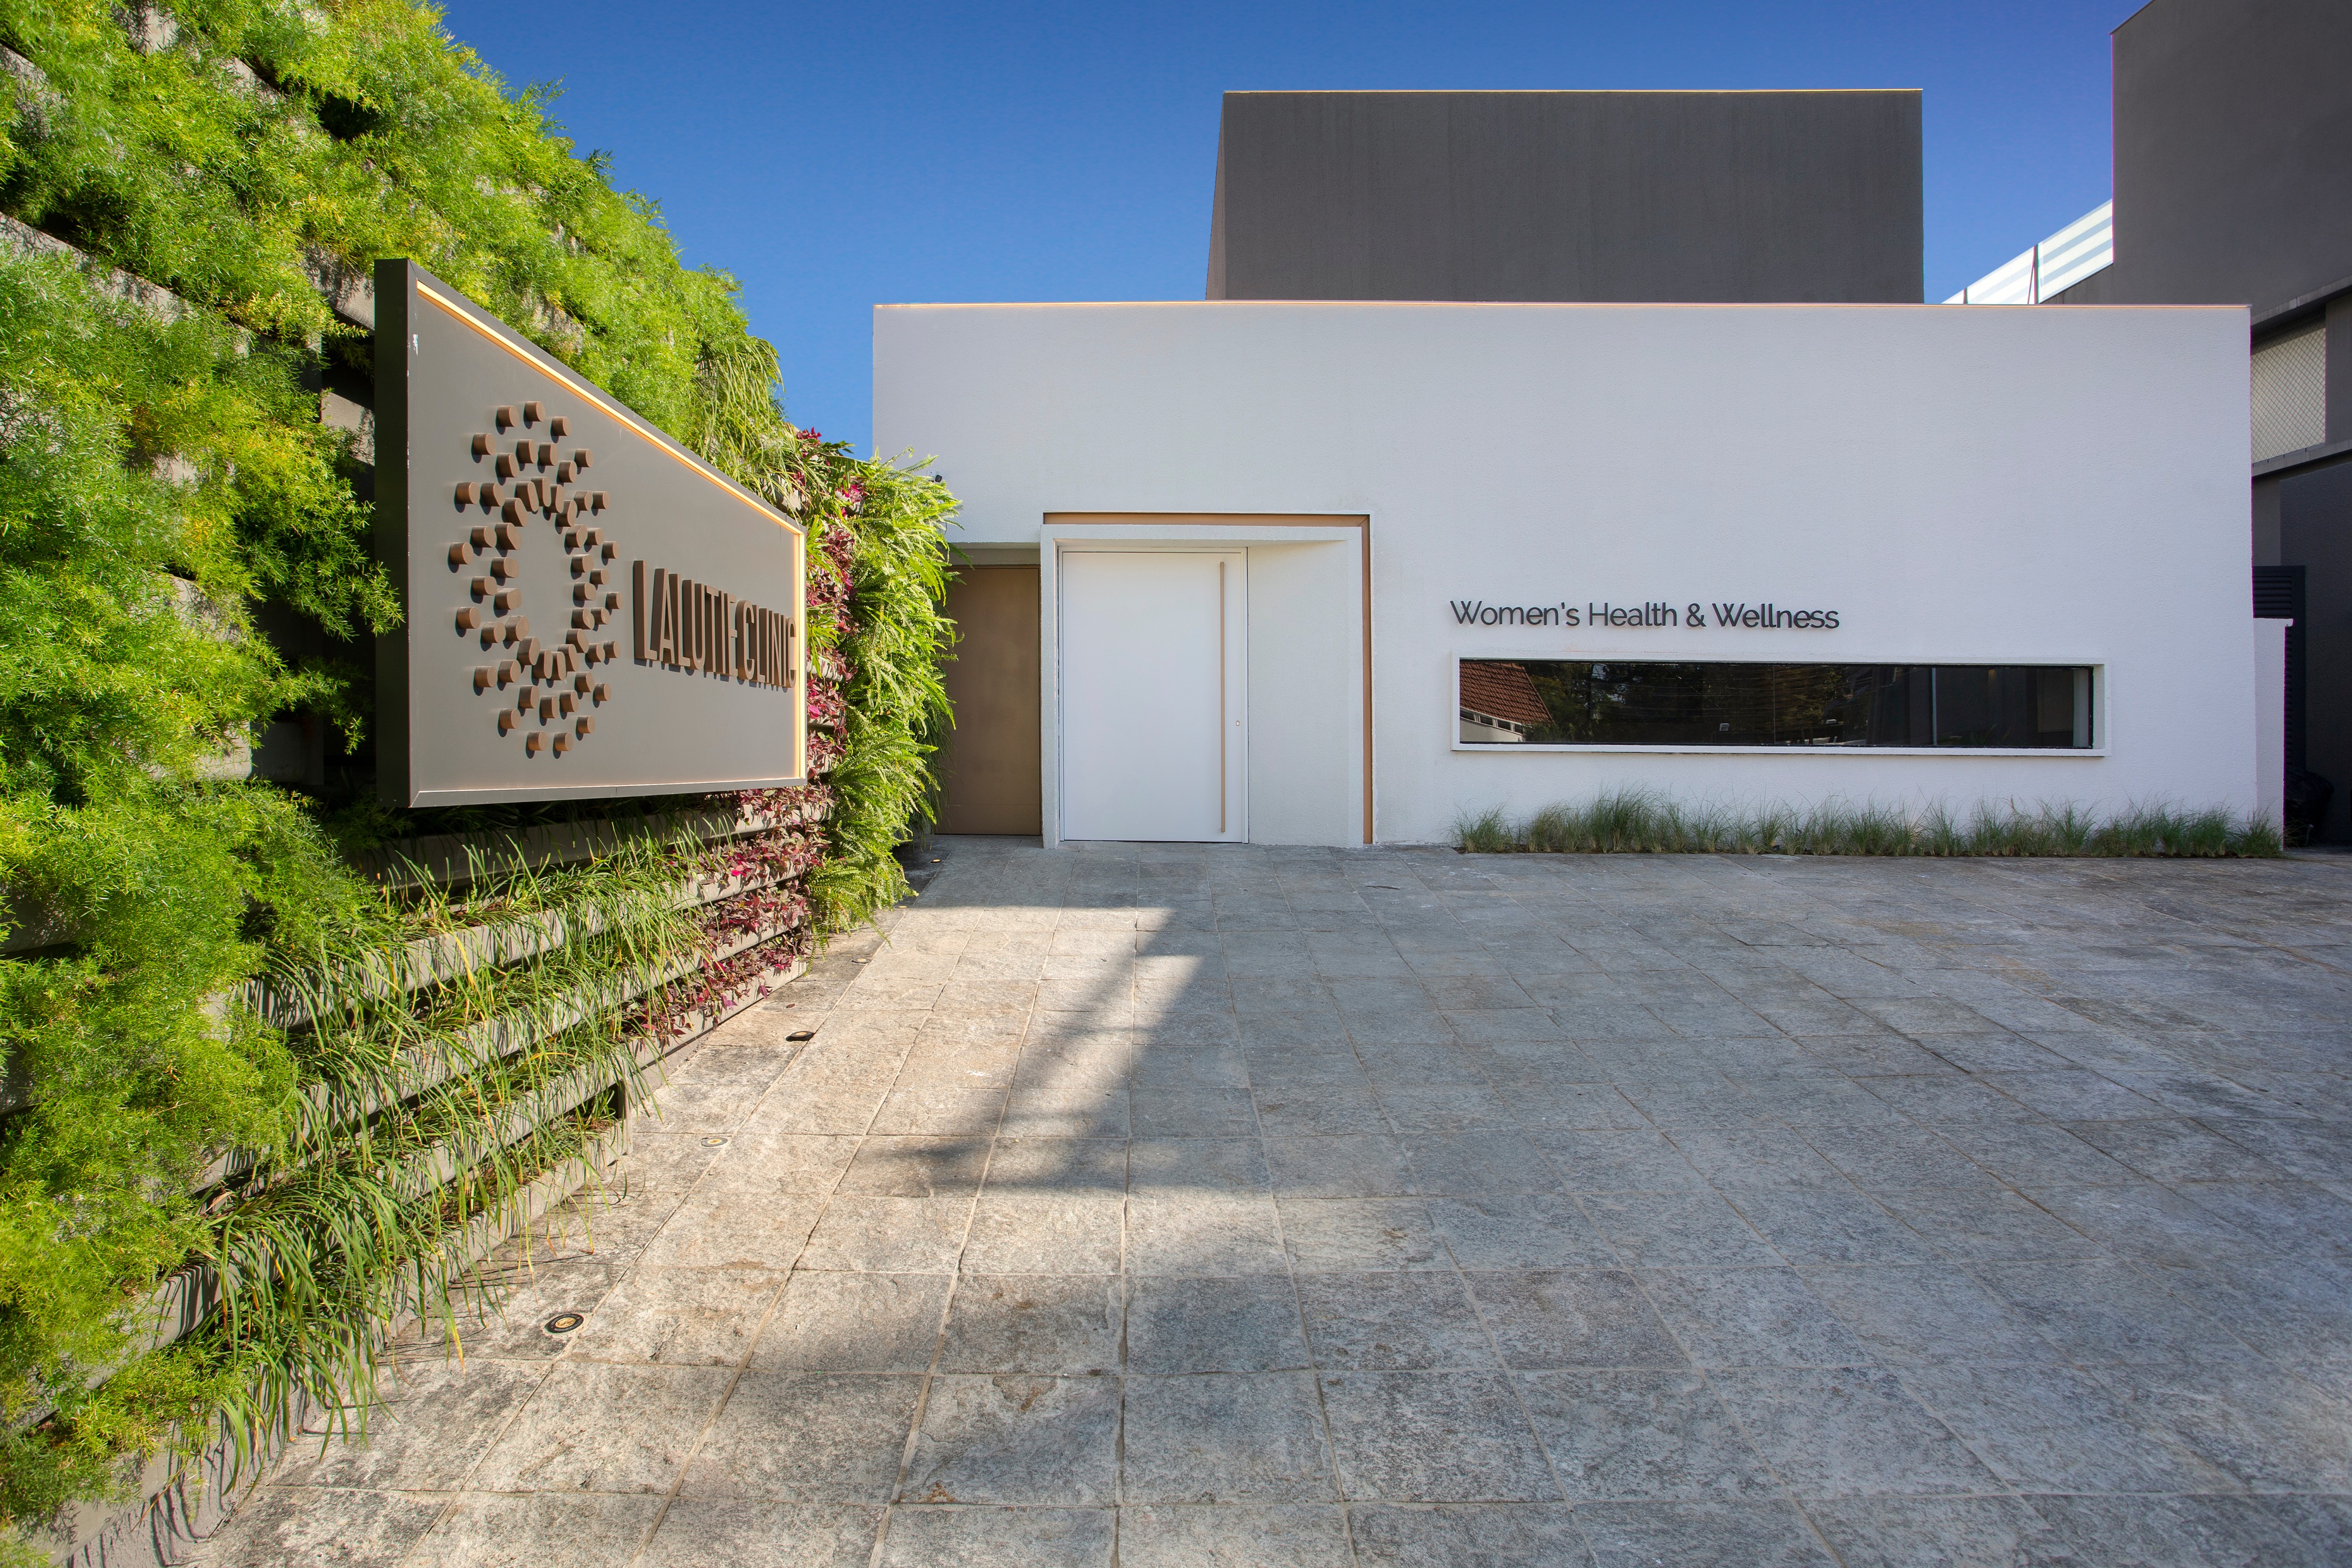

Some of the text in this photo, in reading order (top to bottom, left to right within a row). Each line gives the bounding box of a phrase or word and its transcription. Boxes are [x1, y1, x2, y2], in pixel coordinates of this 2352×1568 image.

[633, 559, 797, 689] LALUTIE CLINIC
[1450, 600, 1840, 629] Women's Health & Wellness
